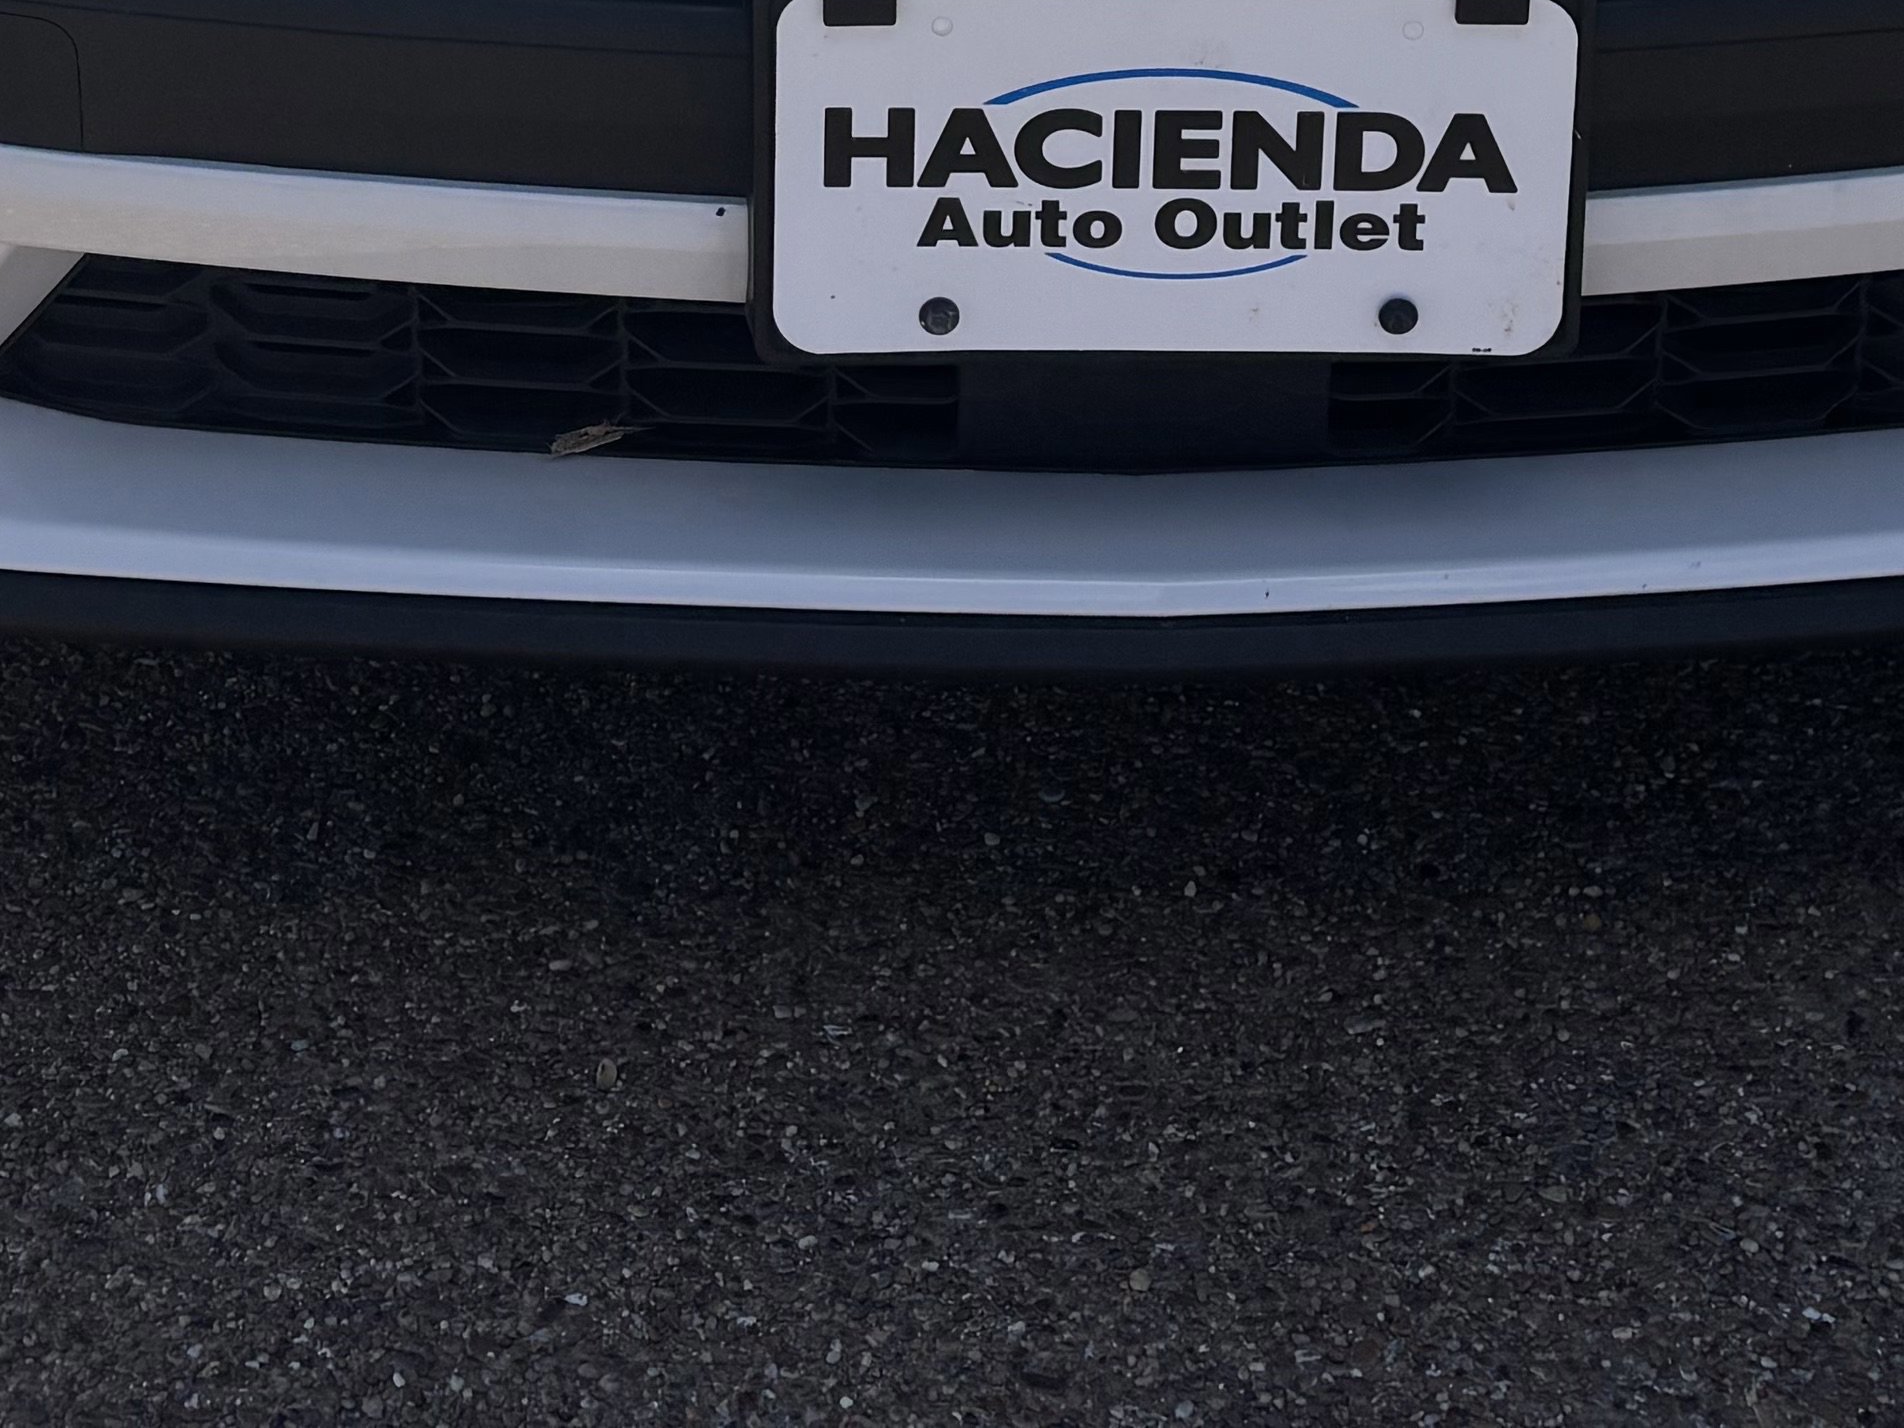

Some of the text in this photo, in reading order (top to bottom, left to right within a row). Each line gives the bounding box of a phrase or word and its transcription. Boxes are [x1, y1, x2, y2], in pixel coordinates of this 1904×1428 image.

[823, 107, 1517, 193] HACIENDA
[917, 197, 1425, 251] Auto Outlet
